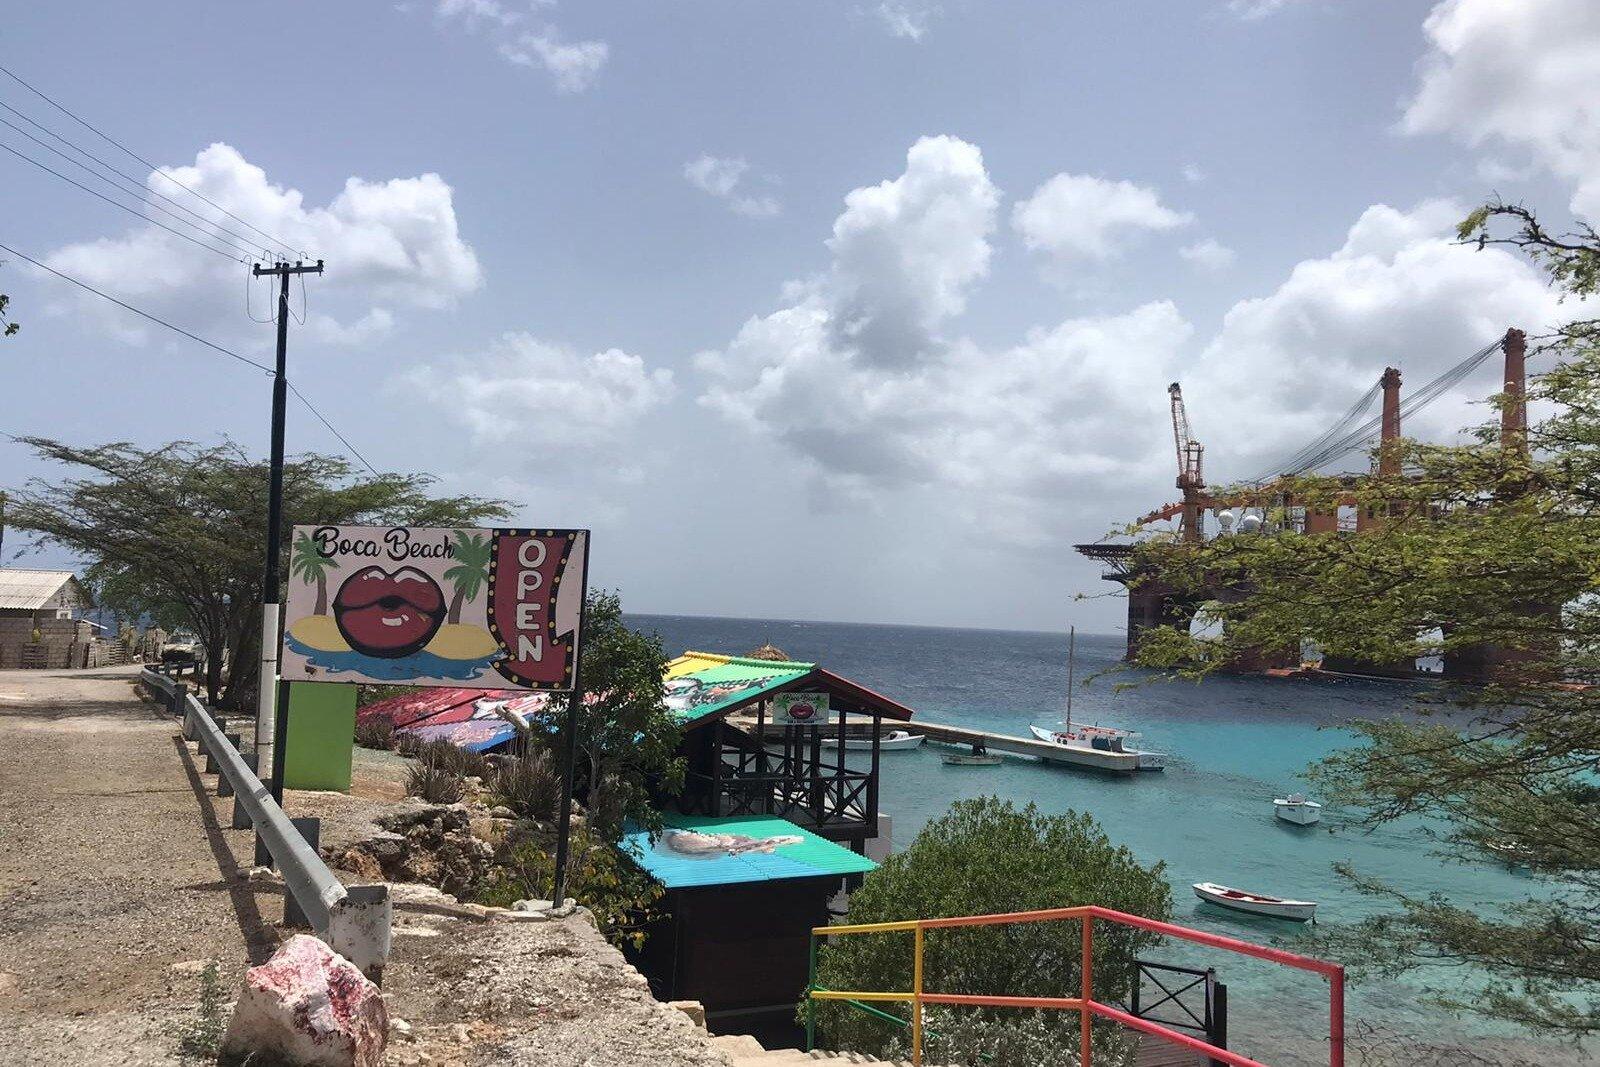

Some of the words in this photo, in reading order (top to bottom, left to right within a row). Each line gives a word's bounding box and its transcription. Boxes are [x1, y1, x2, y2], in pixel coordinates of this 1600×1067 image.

[312, 526, 382, 558] Boca
[384, 527, 455, 561] Beach
[516, 539, 547, 662] OPEN
